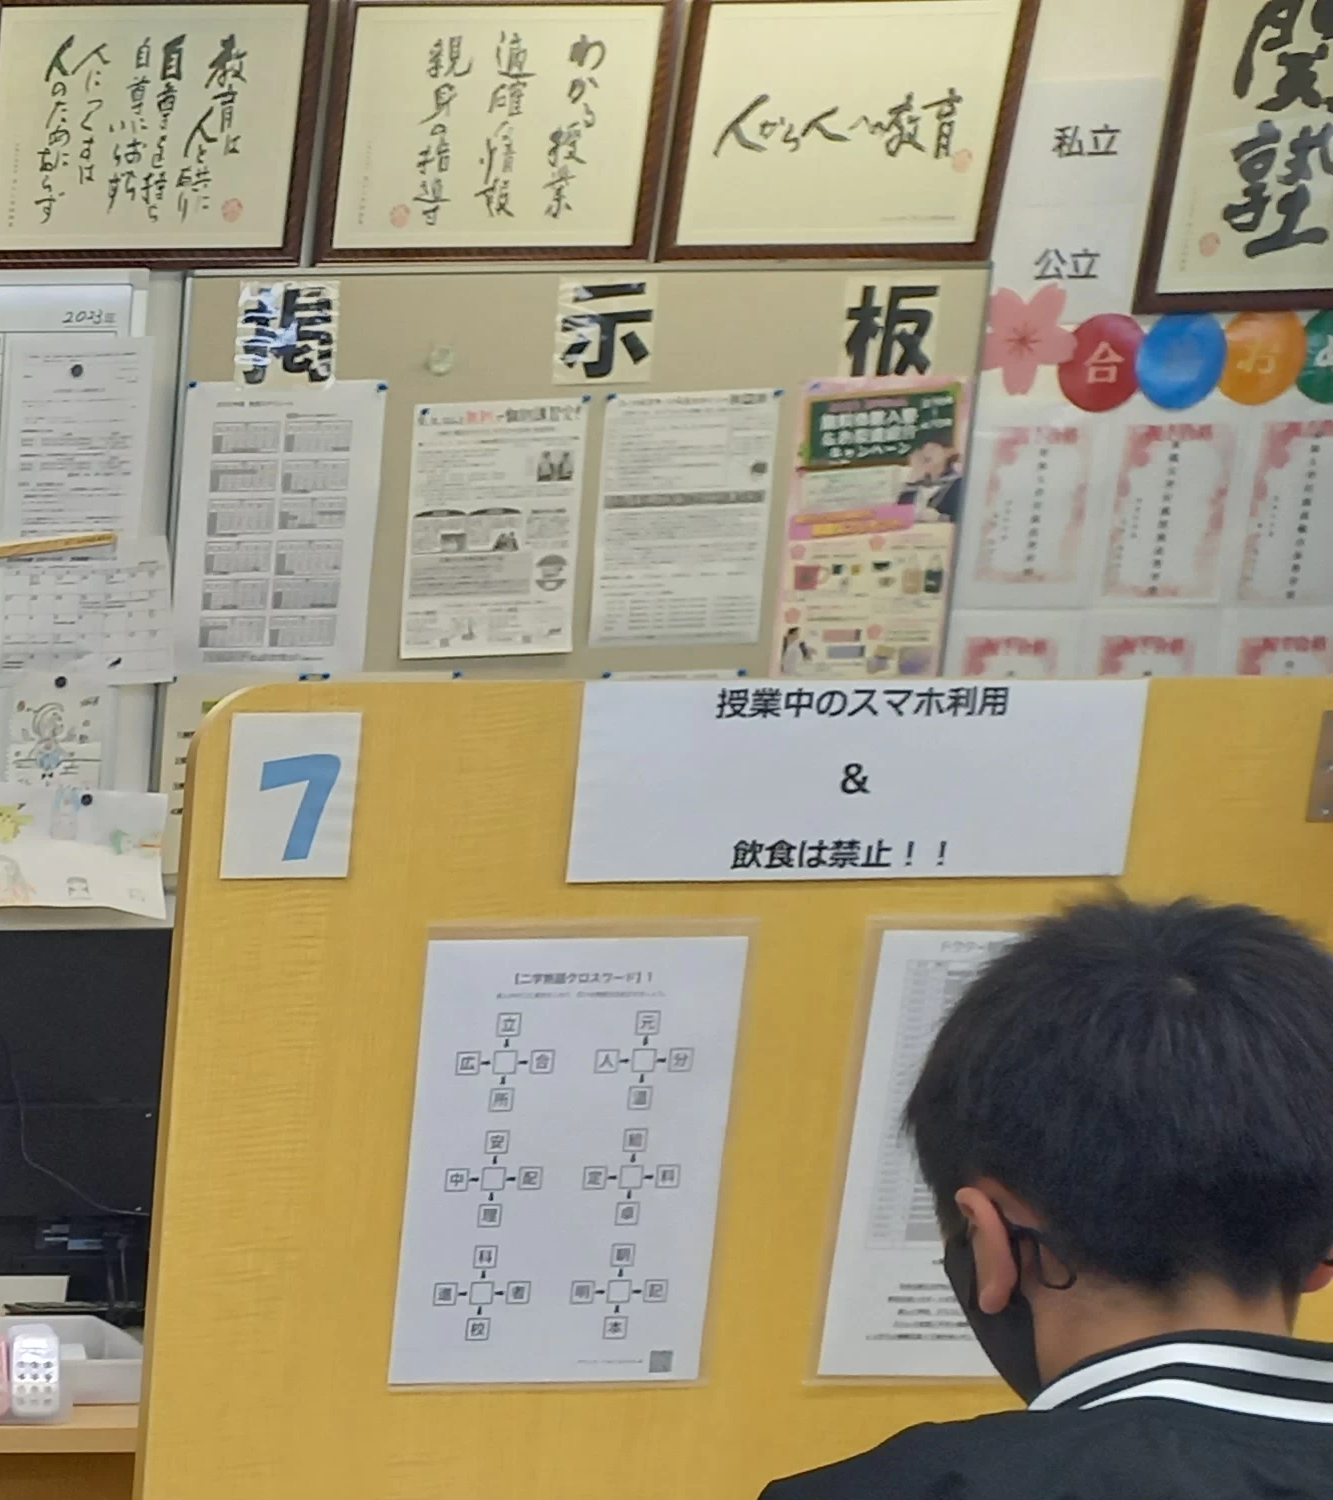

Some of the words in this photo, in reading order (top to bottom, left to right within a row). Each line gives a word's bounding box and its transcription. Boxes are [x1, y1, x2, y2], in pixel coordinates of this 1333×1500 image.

[1052, 124, 1121, 158] 私立
[1034, 248, 1101, 281] 公立
[559, 282, 653, 378] 示
[846, 285, 940, 376] 板
[1084, 341, 1124, 384] 合
[1237, 341, 1276, 374] お
[716, 687, 1009, 719] 授業中のスマホ利用
[840, 763, 871, 796] &
[259, 753, 342, 861] 7
